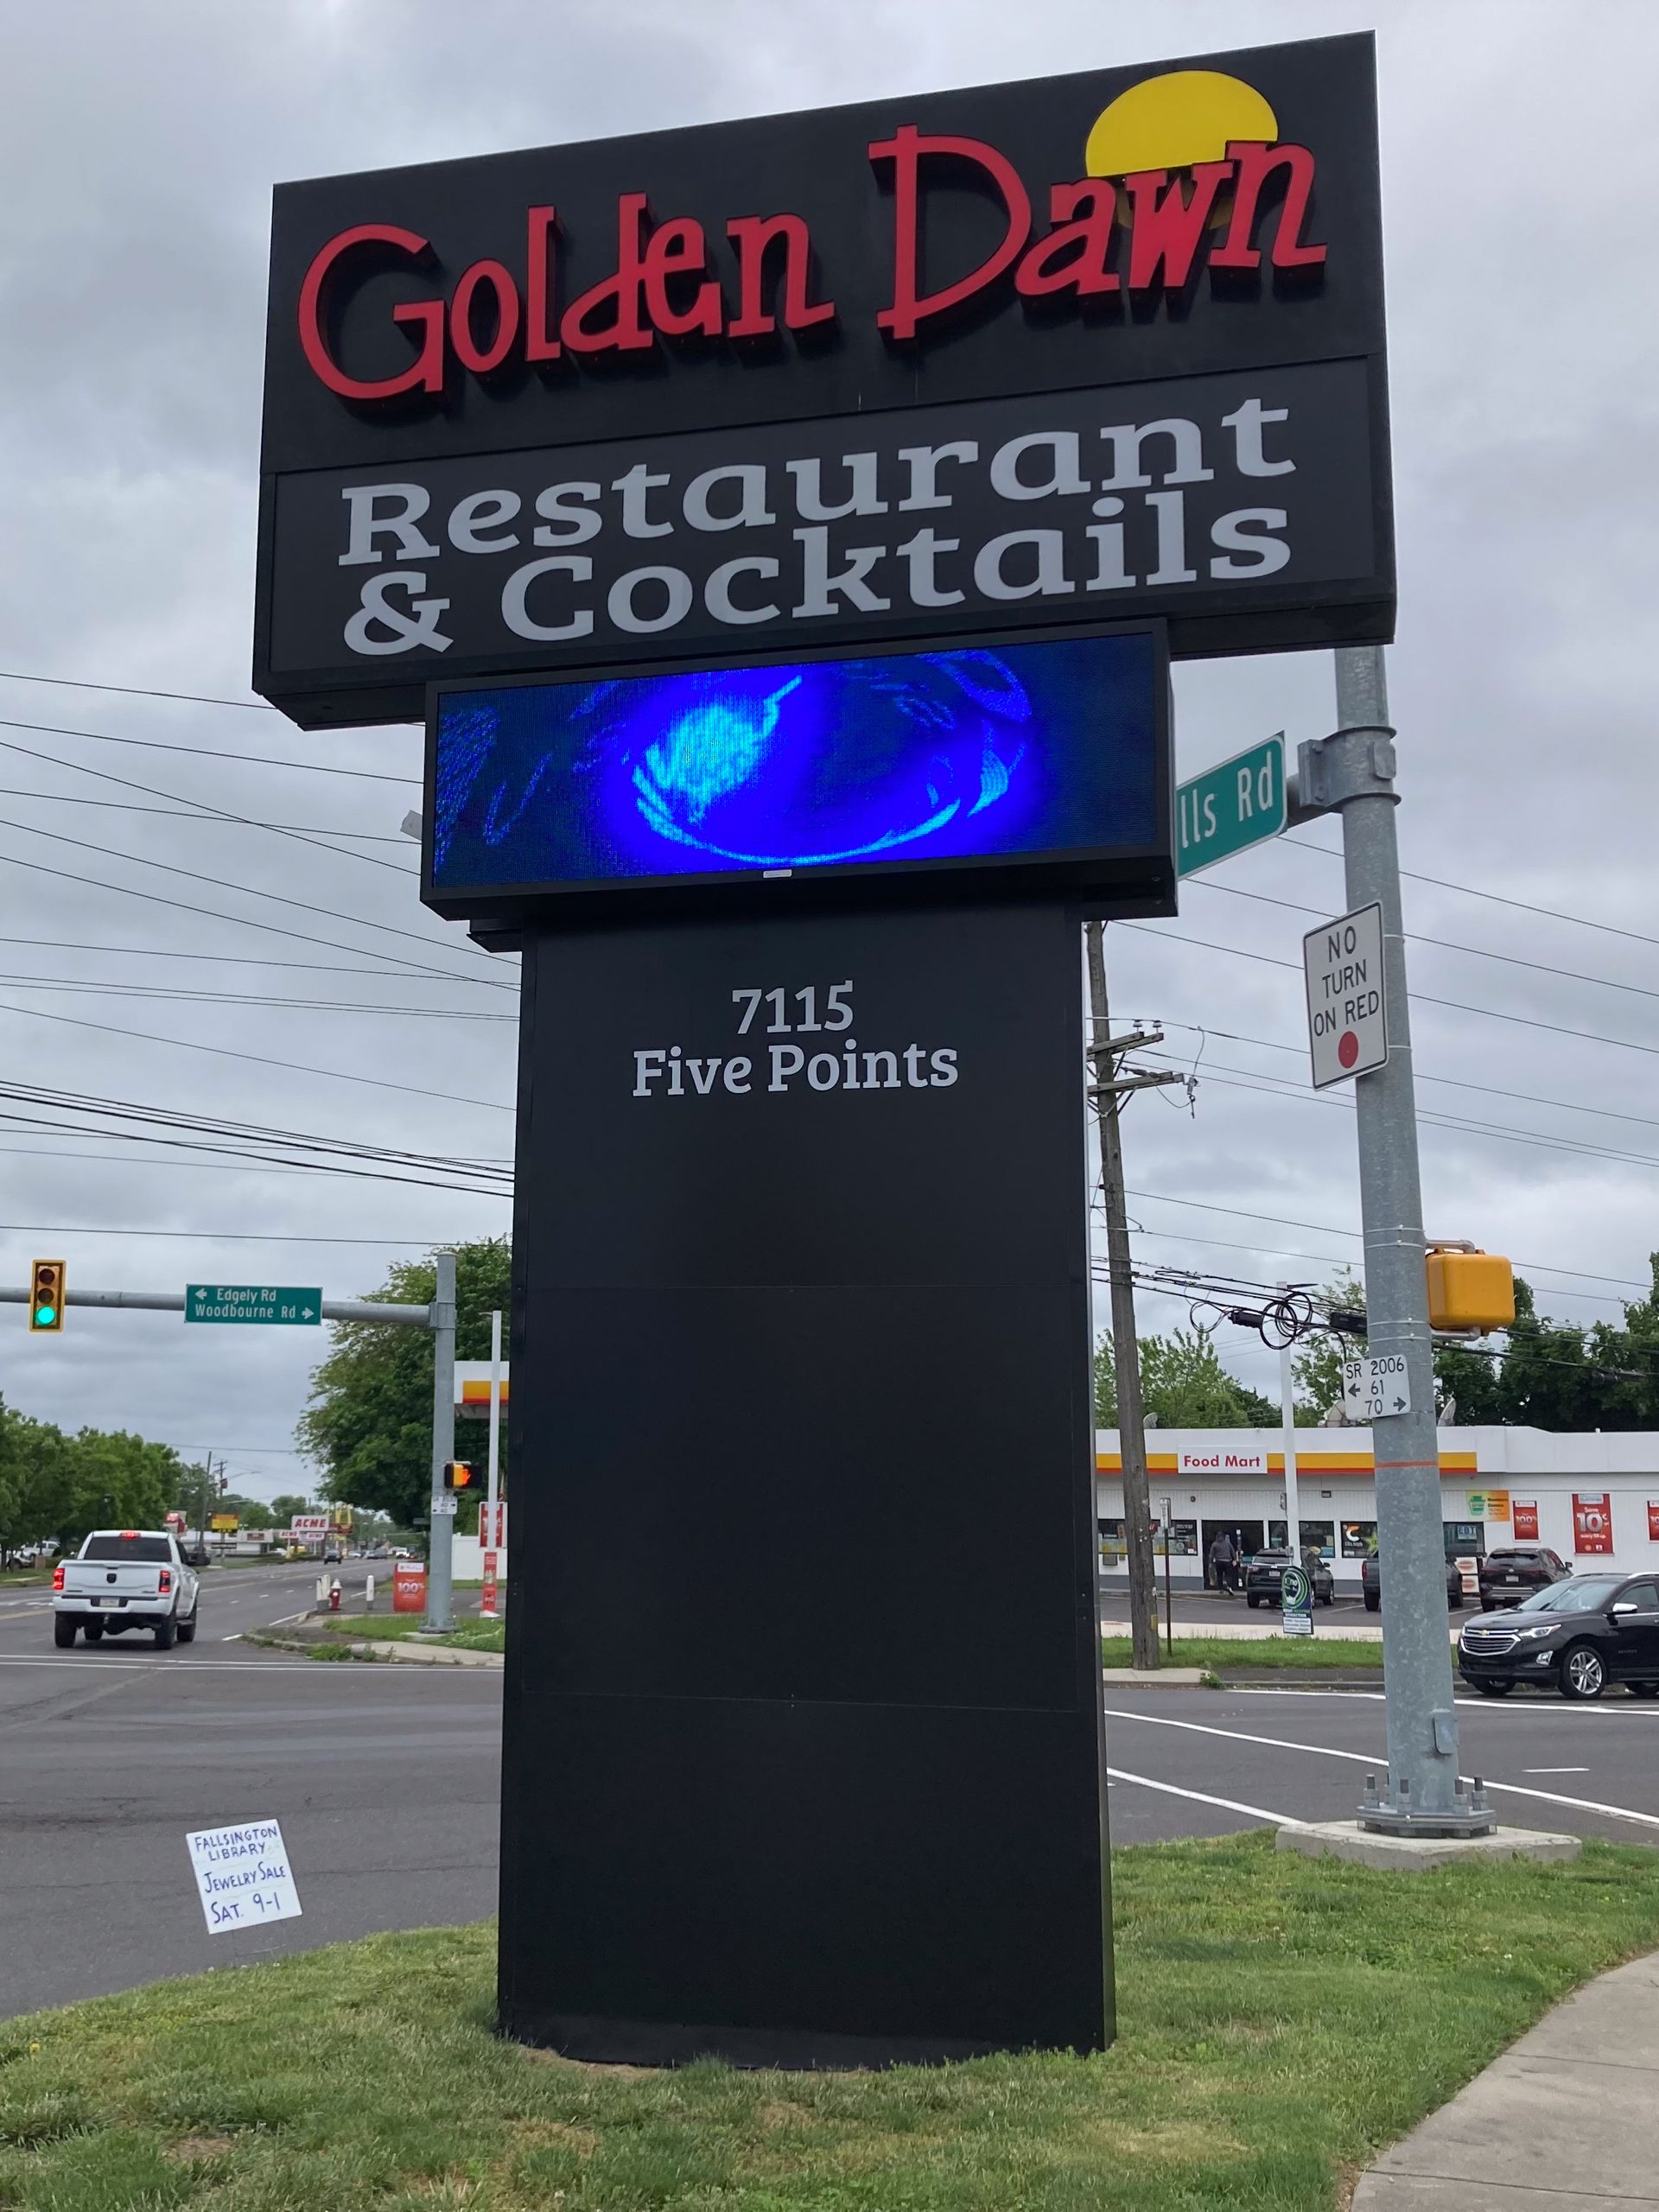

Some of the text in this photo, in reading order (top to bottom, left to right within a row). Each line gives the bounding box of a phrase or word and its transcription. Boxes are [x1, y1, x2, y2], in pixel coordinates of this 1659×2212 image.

[297, 124, 1328, 400] Golden Dawn
[338, 397, 1297, 566] Restaurant
[343, 489, 1291, 656] & Cocktails
[1236, 750, 1274, 822] Rd
[1327, 925, 1357, 963] NO
[1321, 958, 1367, 999] TURN
[731, 979, 854, 1035] 7115
[1313, 989, 1380, 1037] ON RED
[632, 1038, 959, 1097] Five Points
[216, 1287, 276, 1305] Edgely Rd
[194, 1303, 296, 1319] Woodbourne Rd
[1345, 1357, 1404, 1379] SR 2006
[1370, 1379, 1384, 1395] 61
[1364, 1399, 1382, 1415] 70
[1184, 1454, 1261, 1467] Food Mart
[295, 1518, 327, 1528] ACME
[194, 1826, 278, 1852] FALLSINGTON
[208, 1842, 266, 1861] LIBRARY
[204, 1861, 286, 1893] JEWELRY SALE
[252, 1891, 281, 1913] 9-1
